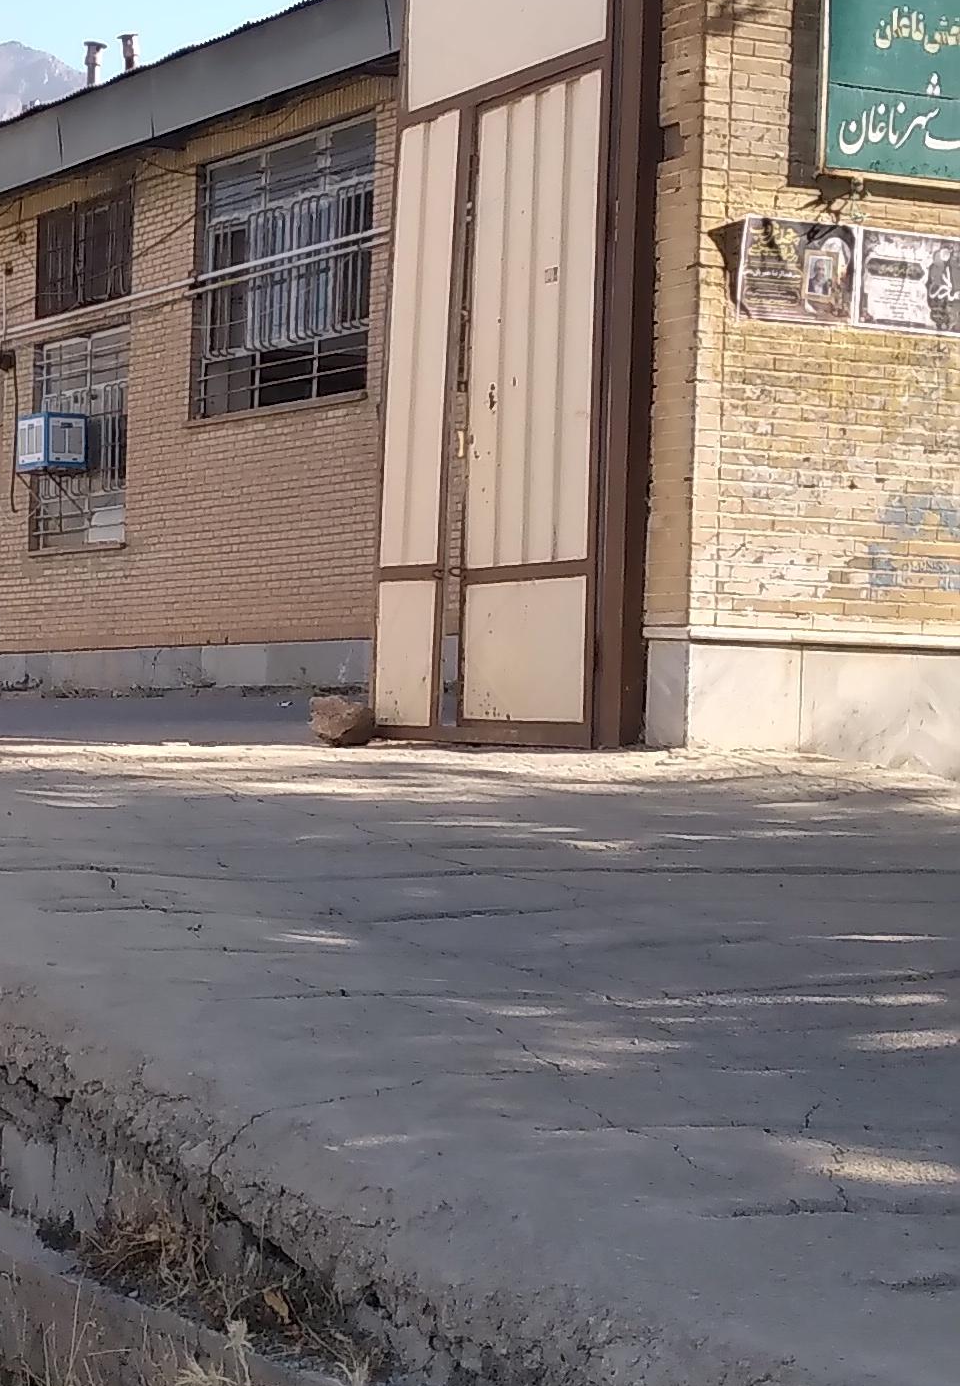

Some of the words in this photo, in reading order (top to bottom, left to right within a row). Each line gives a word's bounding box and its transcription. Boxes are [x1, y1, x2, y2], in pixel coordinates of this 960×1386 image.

[874, 4, 924, 49] ناغان
[839, 101, 906, 155] ناغان
[895, 72, 941, 150] شهر
